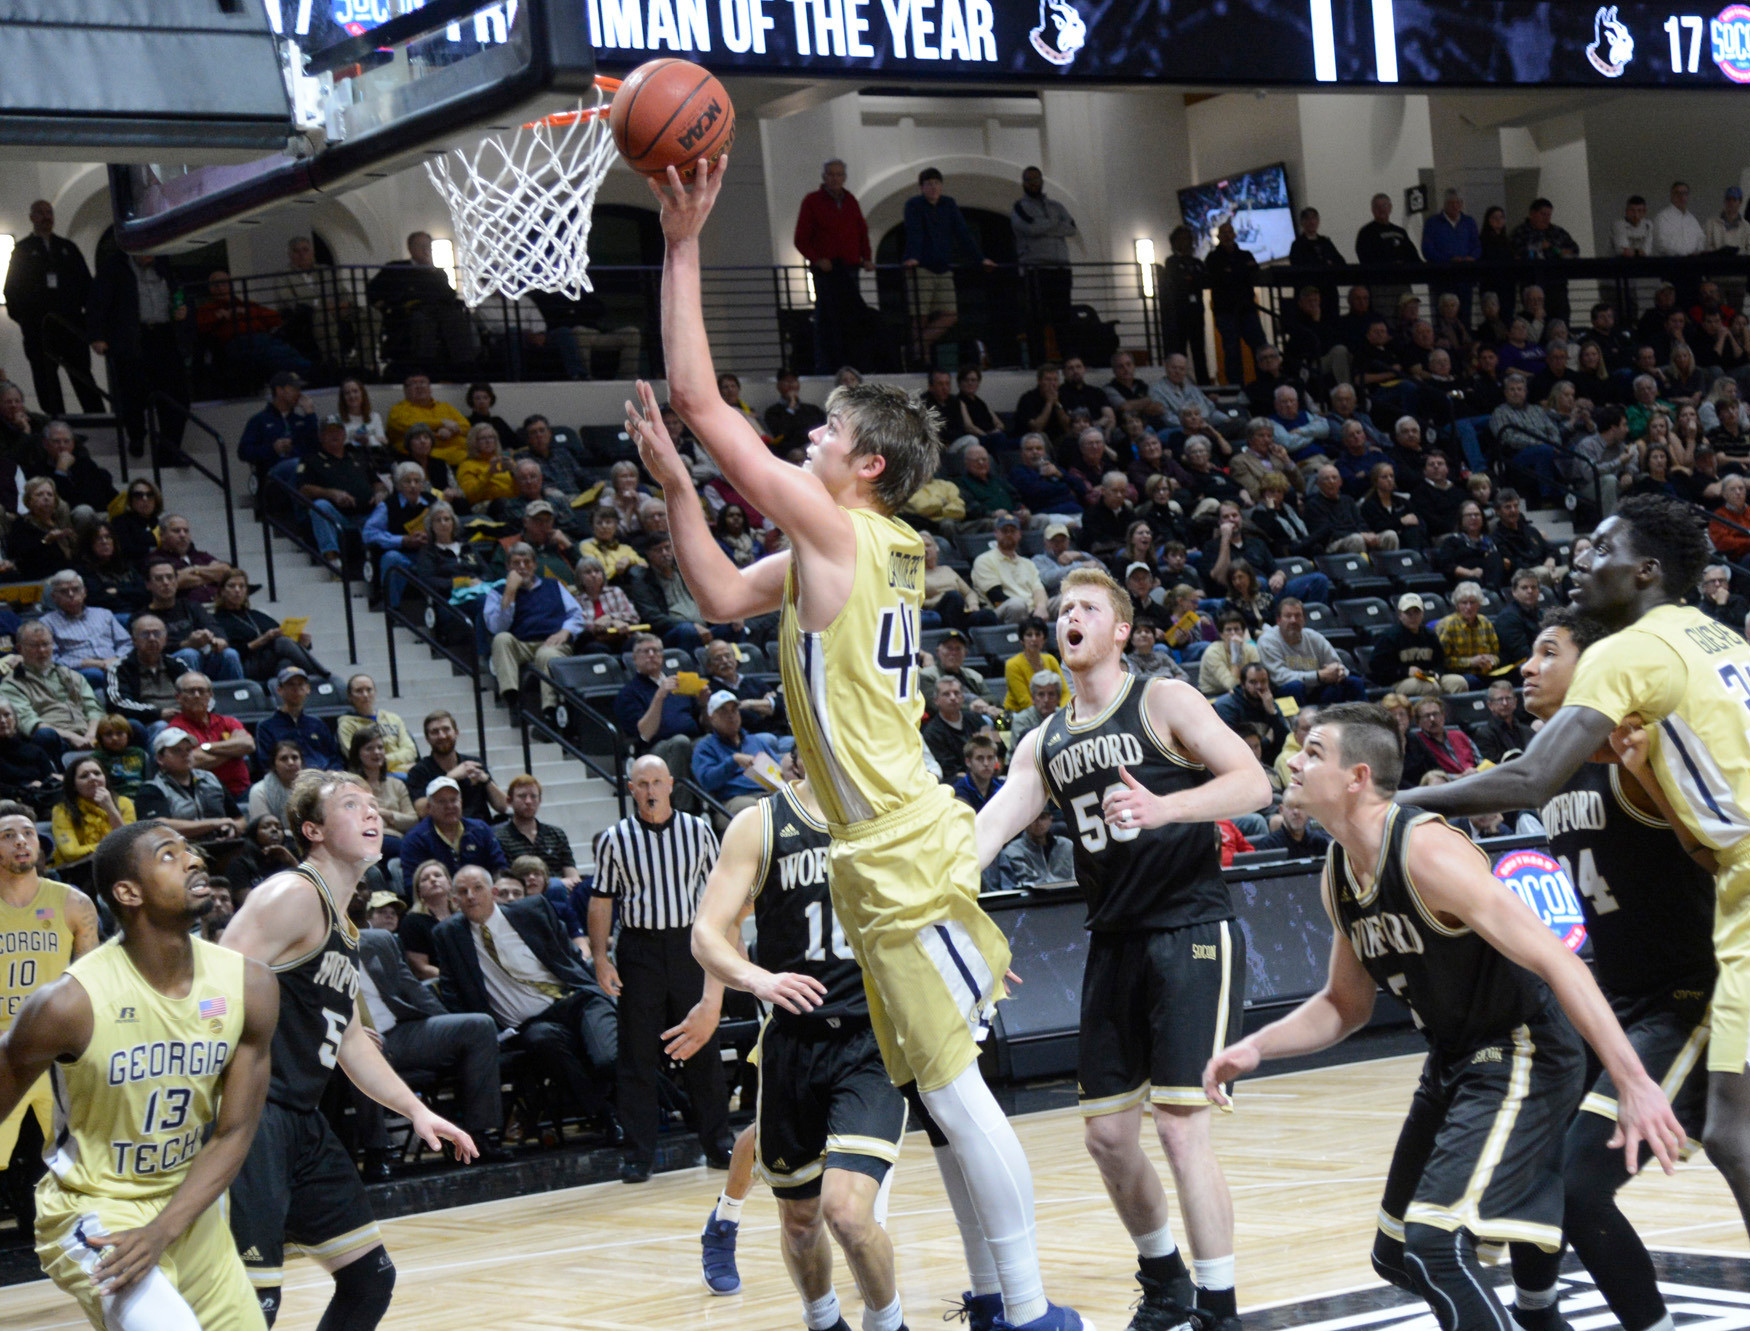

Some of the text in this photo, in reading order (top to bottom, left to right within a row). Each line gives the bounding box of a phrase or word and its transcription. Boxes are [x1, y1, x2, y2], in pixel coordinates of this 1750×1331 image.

[719, 0, 776, 54] OF
[785, 0, 875, 58] THE
[880, 0, 998, 62] YEAR
[1663, 15, 1703, 74] 17
[677, 97, 722, 151] NCAA
[1049, 733, 1144, 792] WOFFORD
[1505, 870, 1583, 928] OCON
[8, 959, 36, 988] 10
[108, 1039, 229, 1087] GEORGIA
[318, 1006, 348, 1070] 5
[141, 1086, 194, 1136] 13
[112, 1126, 204, 1176] TECH
